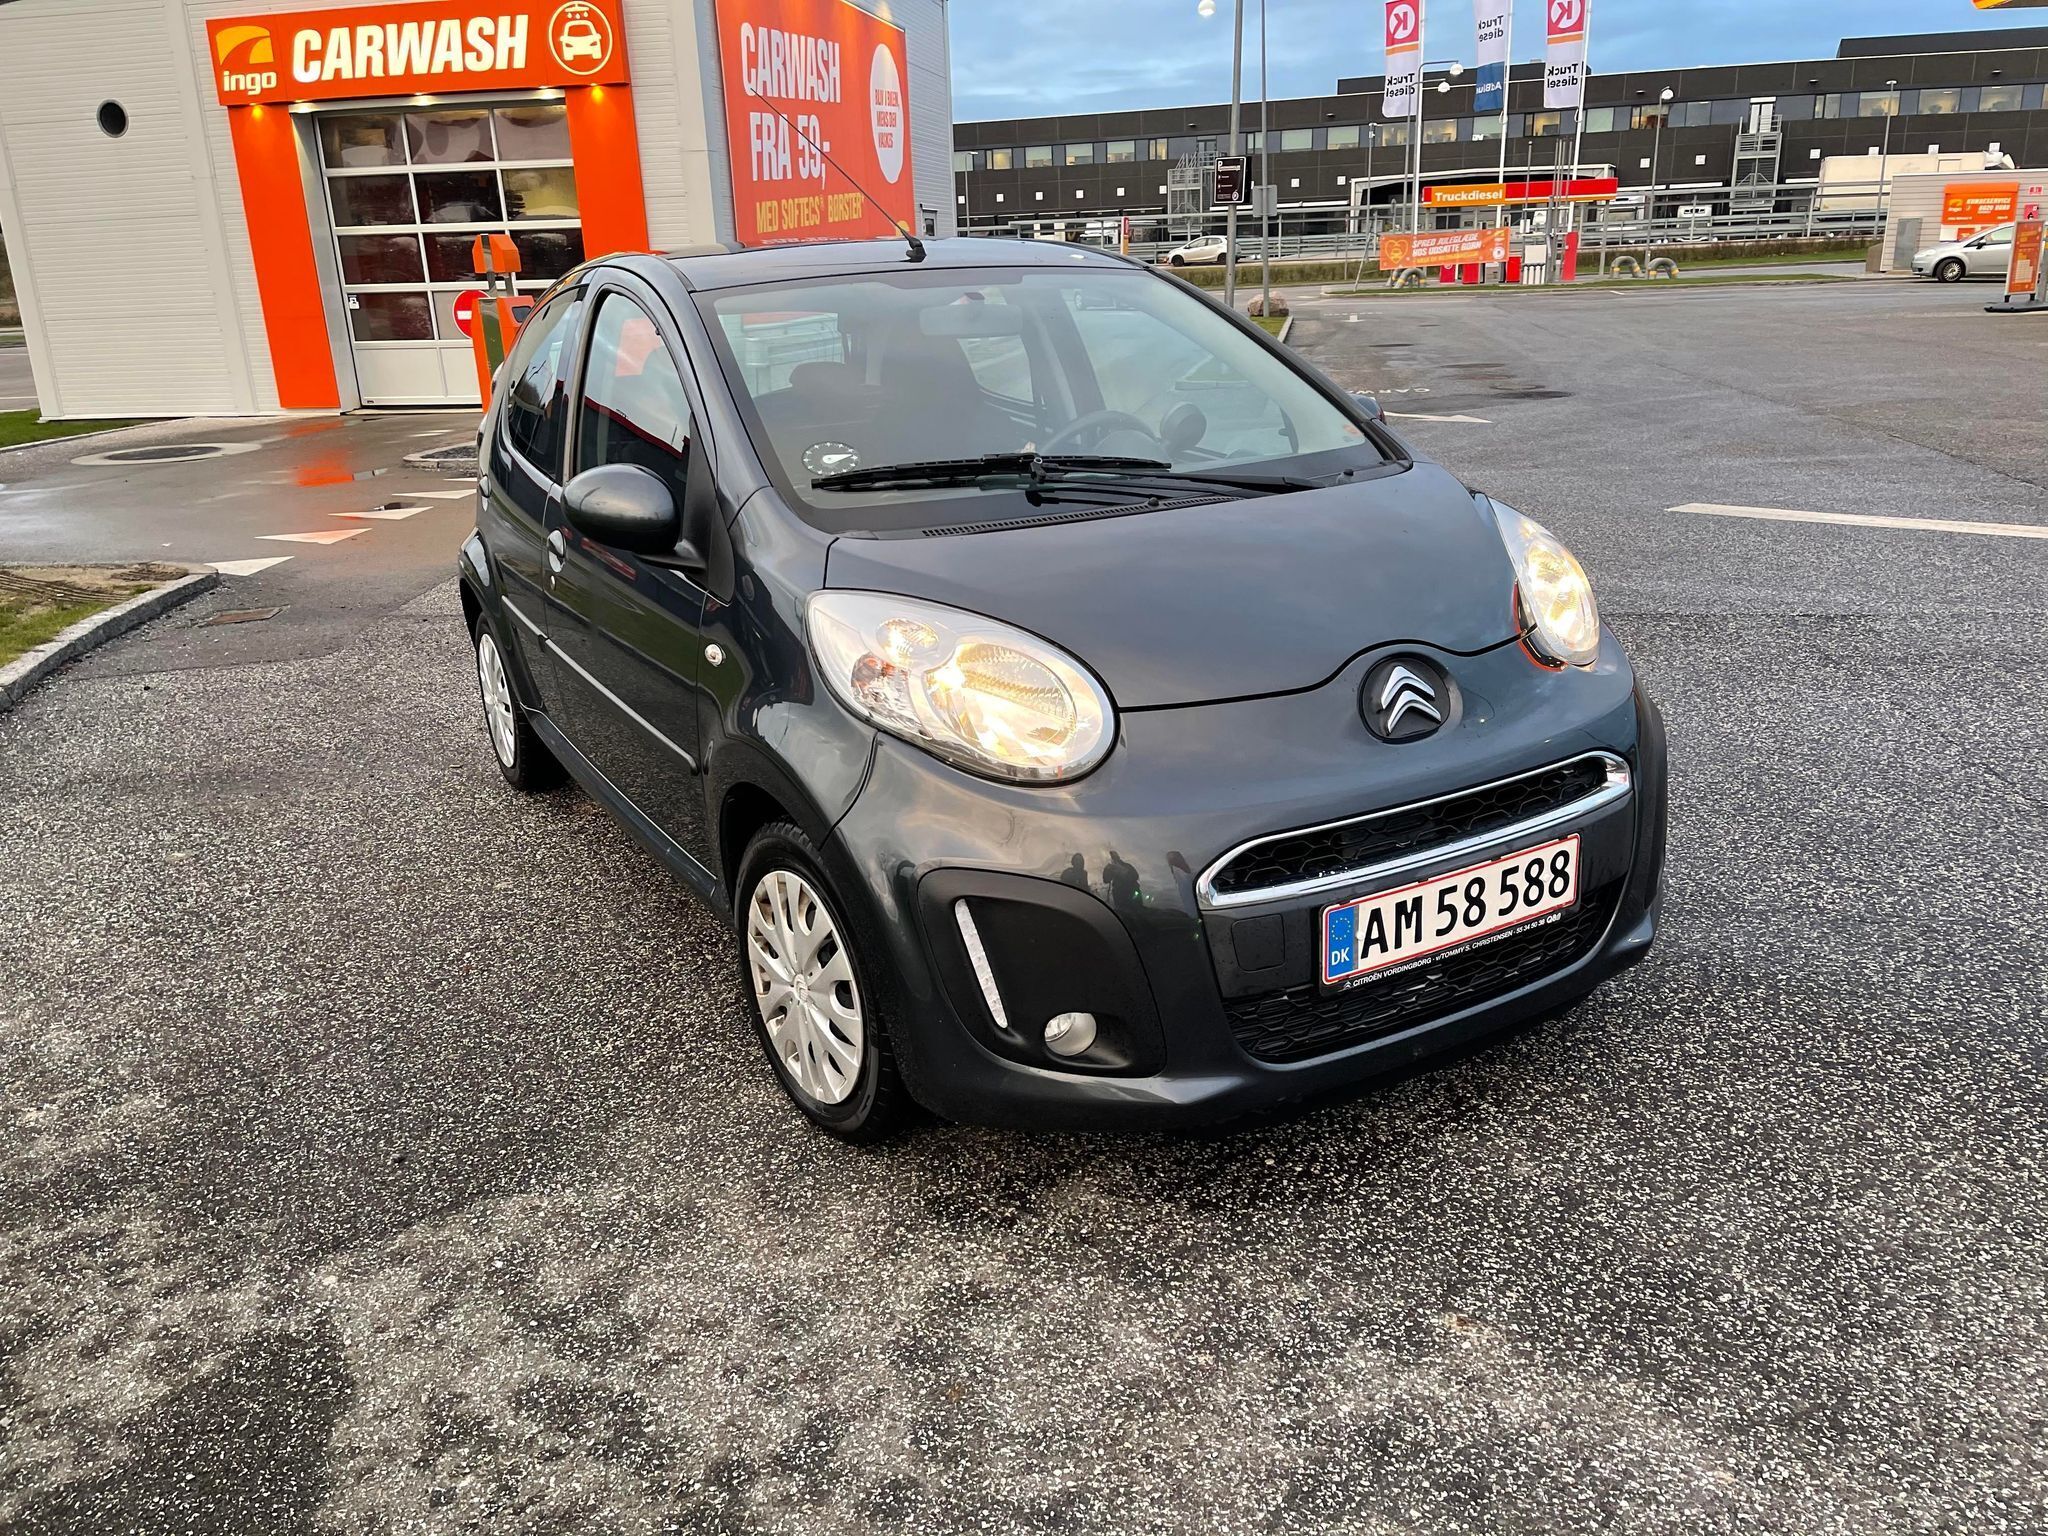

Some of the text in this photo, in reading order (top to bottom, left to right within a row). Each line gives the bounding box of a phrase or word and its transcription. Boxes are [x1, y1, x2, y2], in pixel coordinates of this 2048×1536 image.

[292, 14, 529, 83] CARWASH
[740, 22, 841, 104] CARWASH
[223, 70, 277, 96] ingo
[750, 111, 831, 191] FRA 59,-
[1435, 190, 1502, 202] Truckdiesel
[756, 200, 779, 234] MED
[1412, 237, 1437, 248] SPRED
[1412, 247, 1428, 257] HOS
[1360, 849, 1571, 960] AM 58 588
[1331, 947, 1350, 966] DK
[1352, 972, 1383, 988] CITROËN
[1383, 957, 1432, 979] VORDINGBORG
[1472, 929, 1513, 949] CHRISTENSEN
